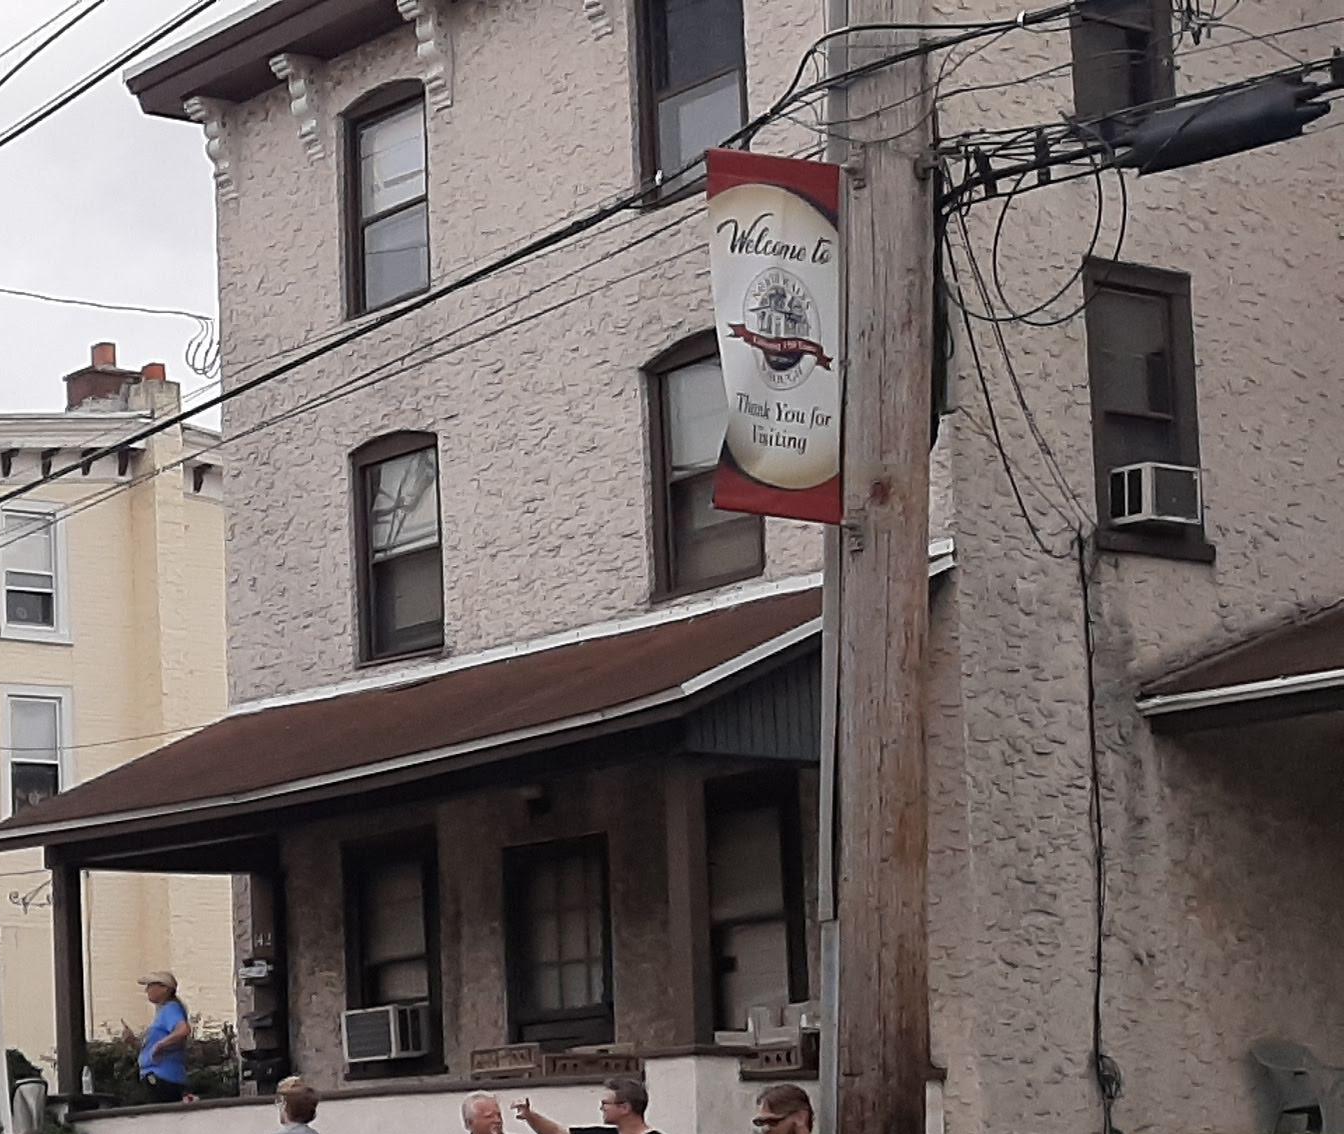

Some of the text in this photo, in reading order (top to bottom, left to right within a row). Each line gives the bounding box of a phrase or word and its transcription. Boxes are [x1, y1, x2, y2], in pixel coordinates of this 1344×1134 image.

[716, 212, 832, 265] Welcome to
[736, 391, 832, 429] Thank You for
